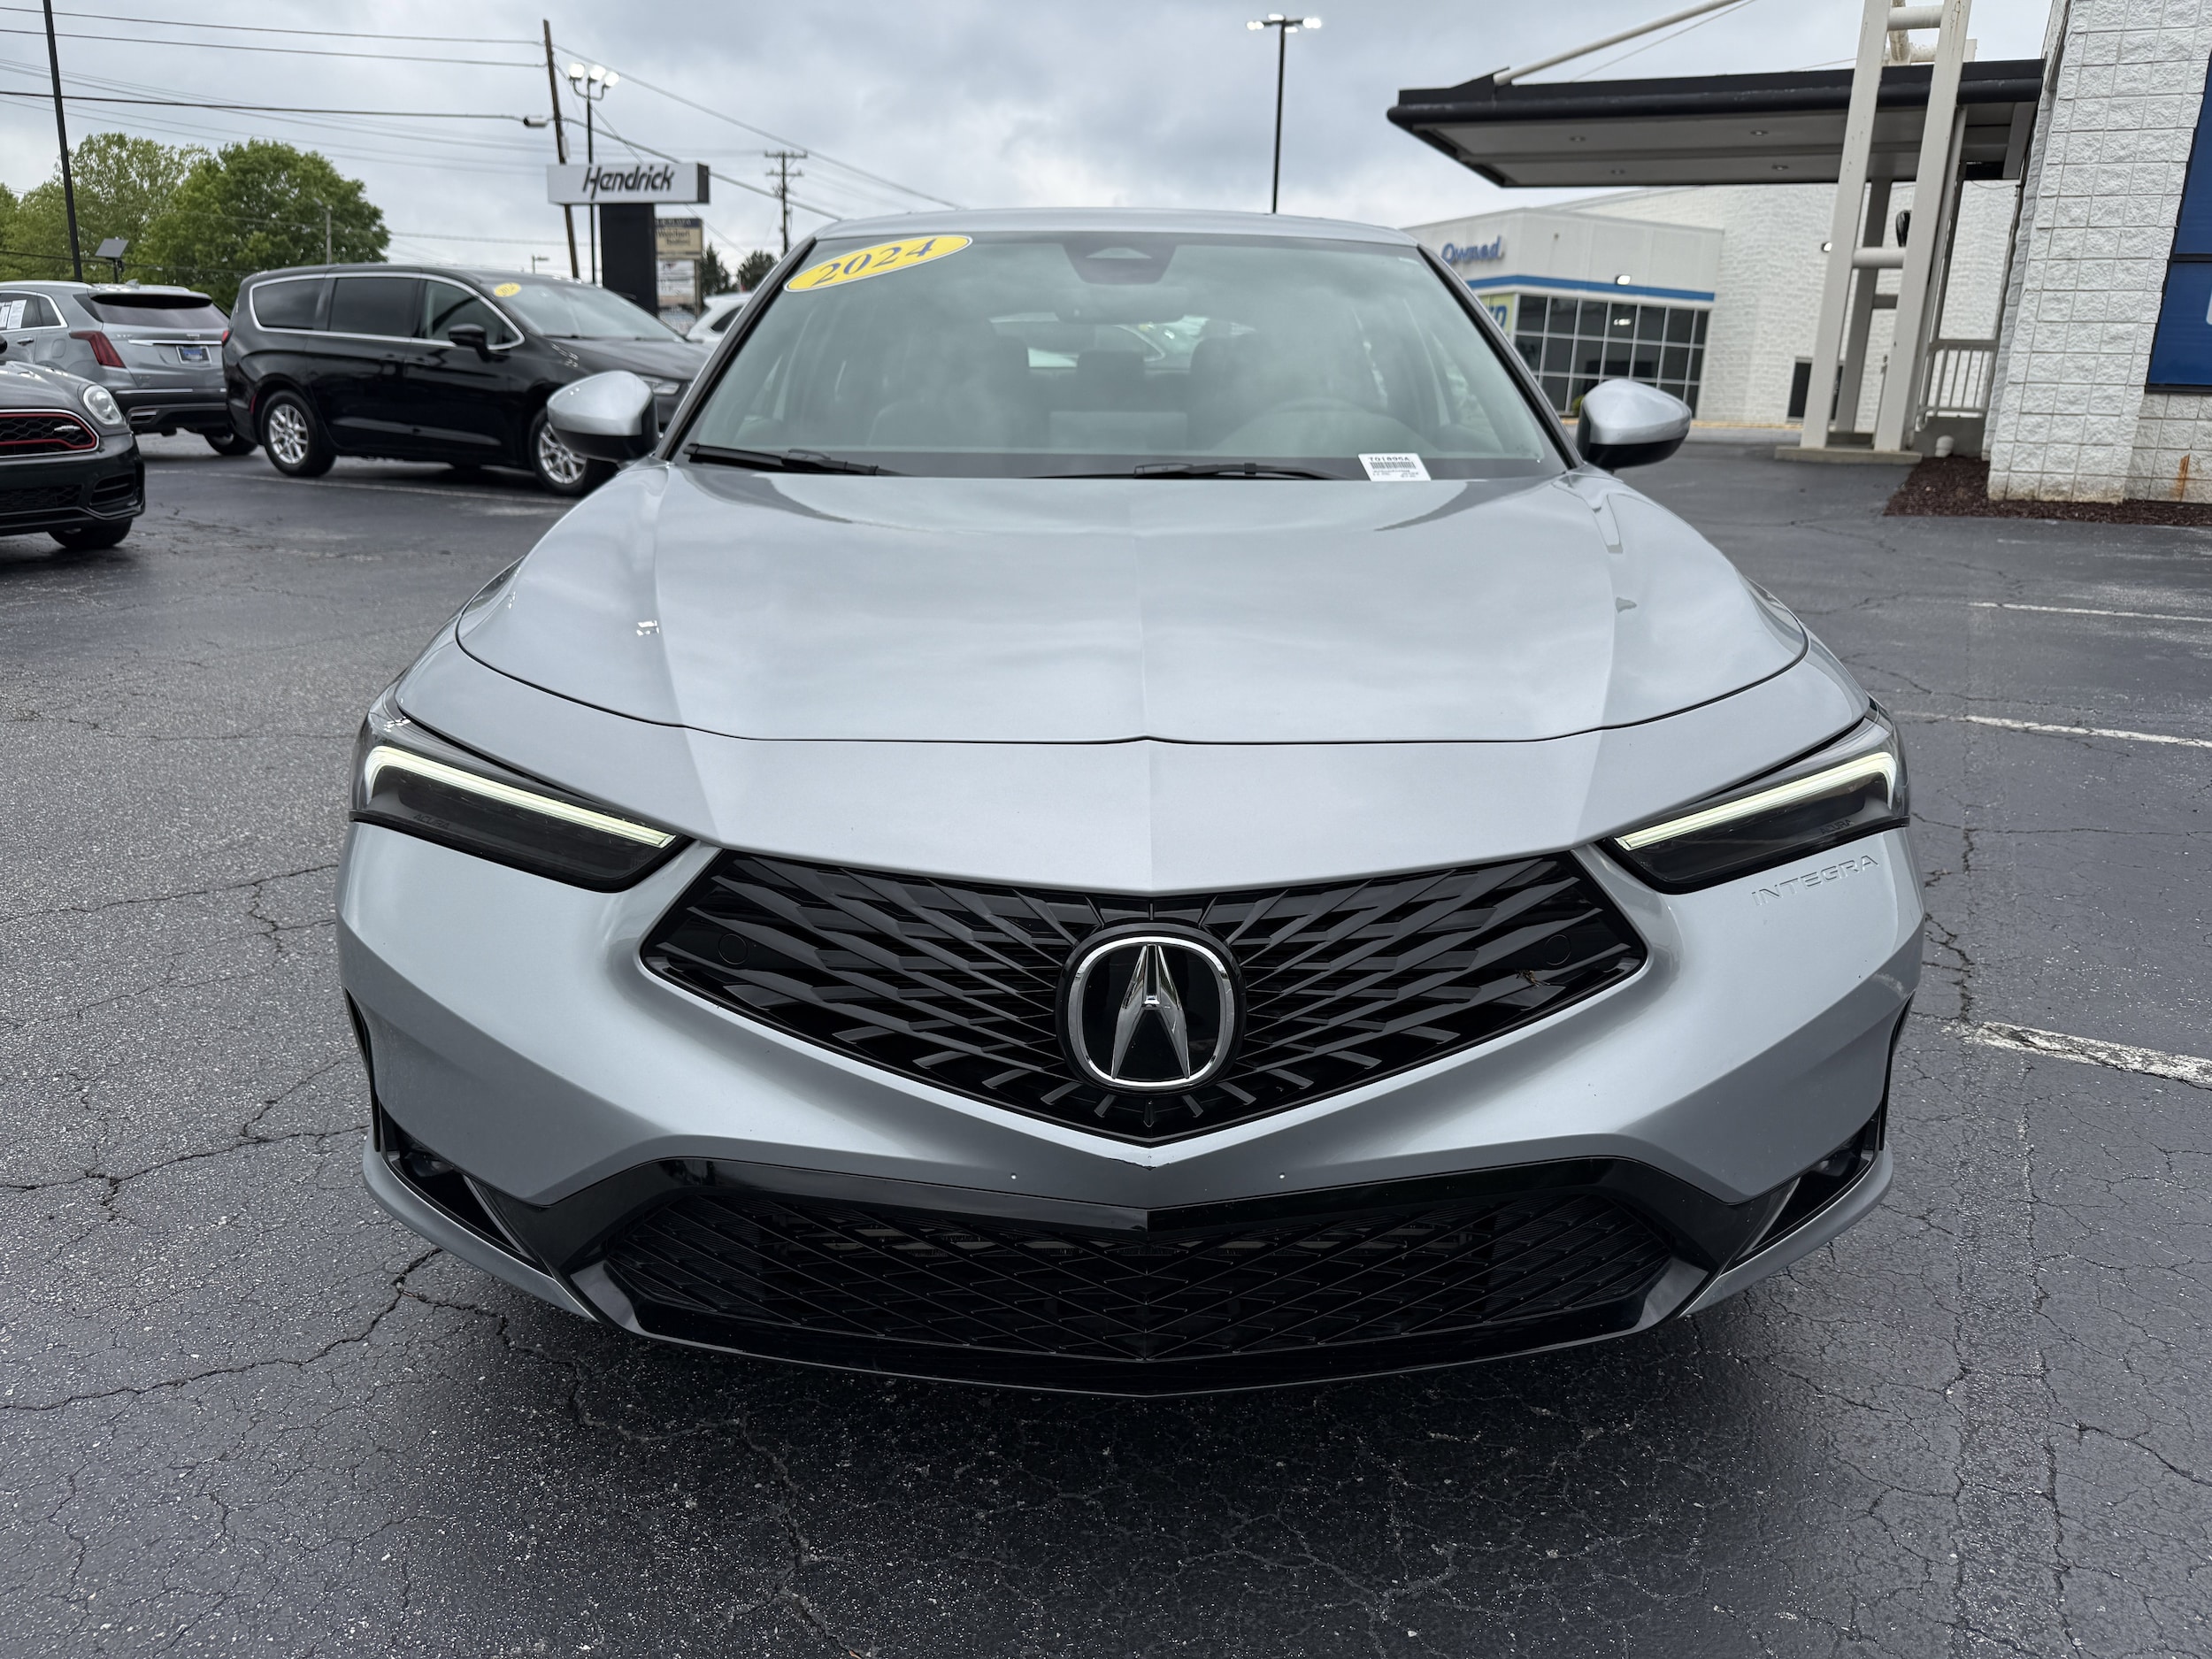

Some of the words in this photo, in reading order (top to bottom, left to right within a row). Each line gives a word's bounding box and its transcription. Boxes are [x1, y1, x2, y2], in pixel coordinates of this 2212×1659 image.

[582, 165, 675, 200] Hendrick
[811, 237, 939, 288] 2024
[1441, 234, 1502, 265] Owned
[413, 814, 450, 830] ACURA
[1819, 819, 1852, 833] ACURA
[1751, 855, 1880, 906] INTEGRA
